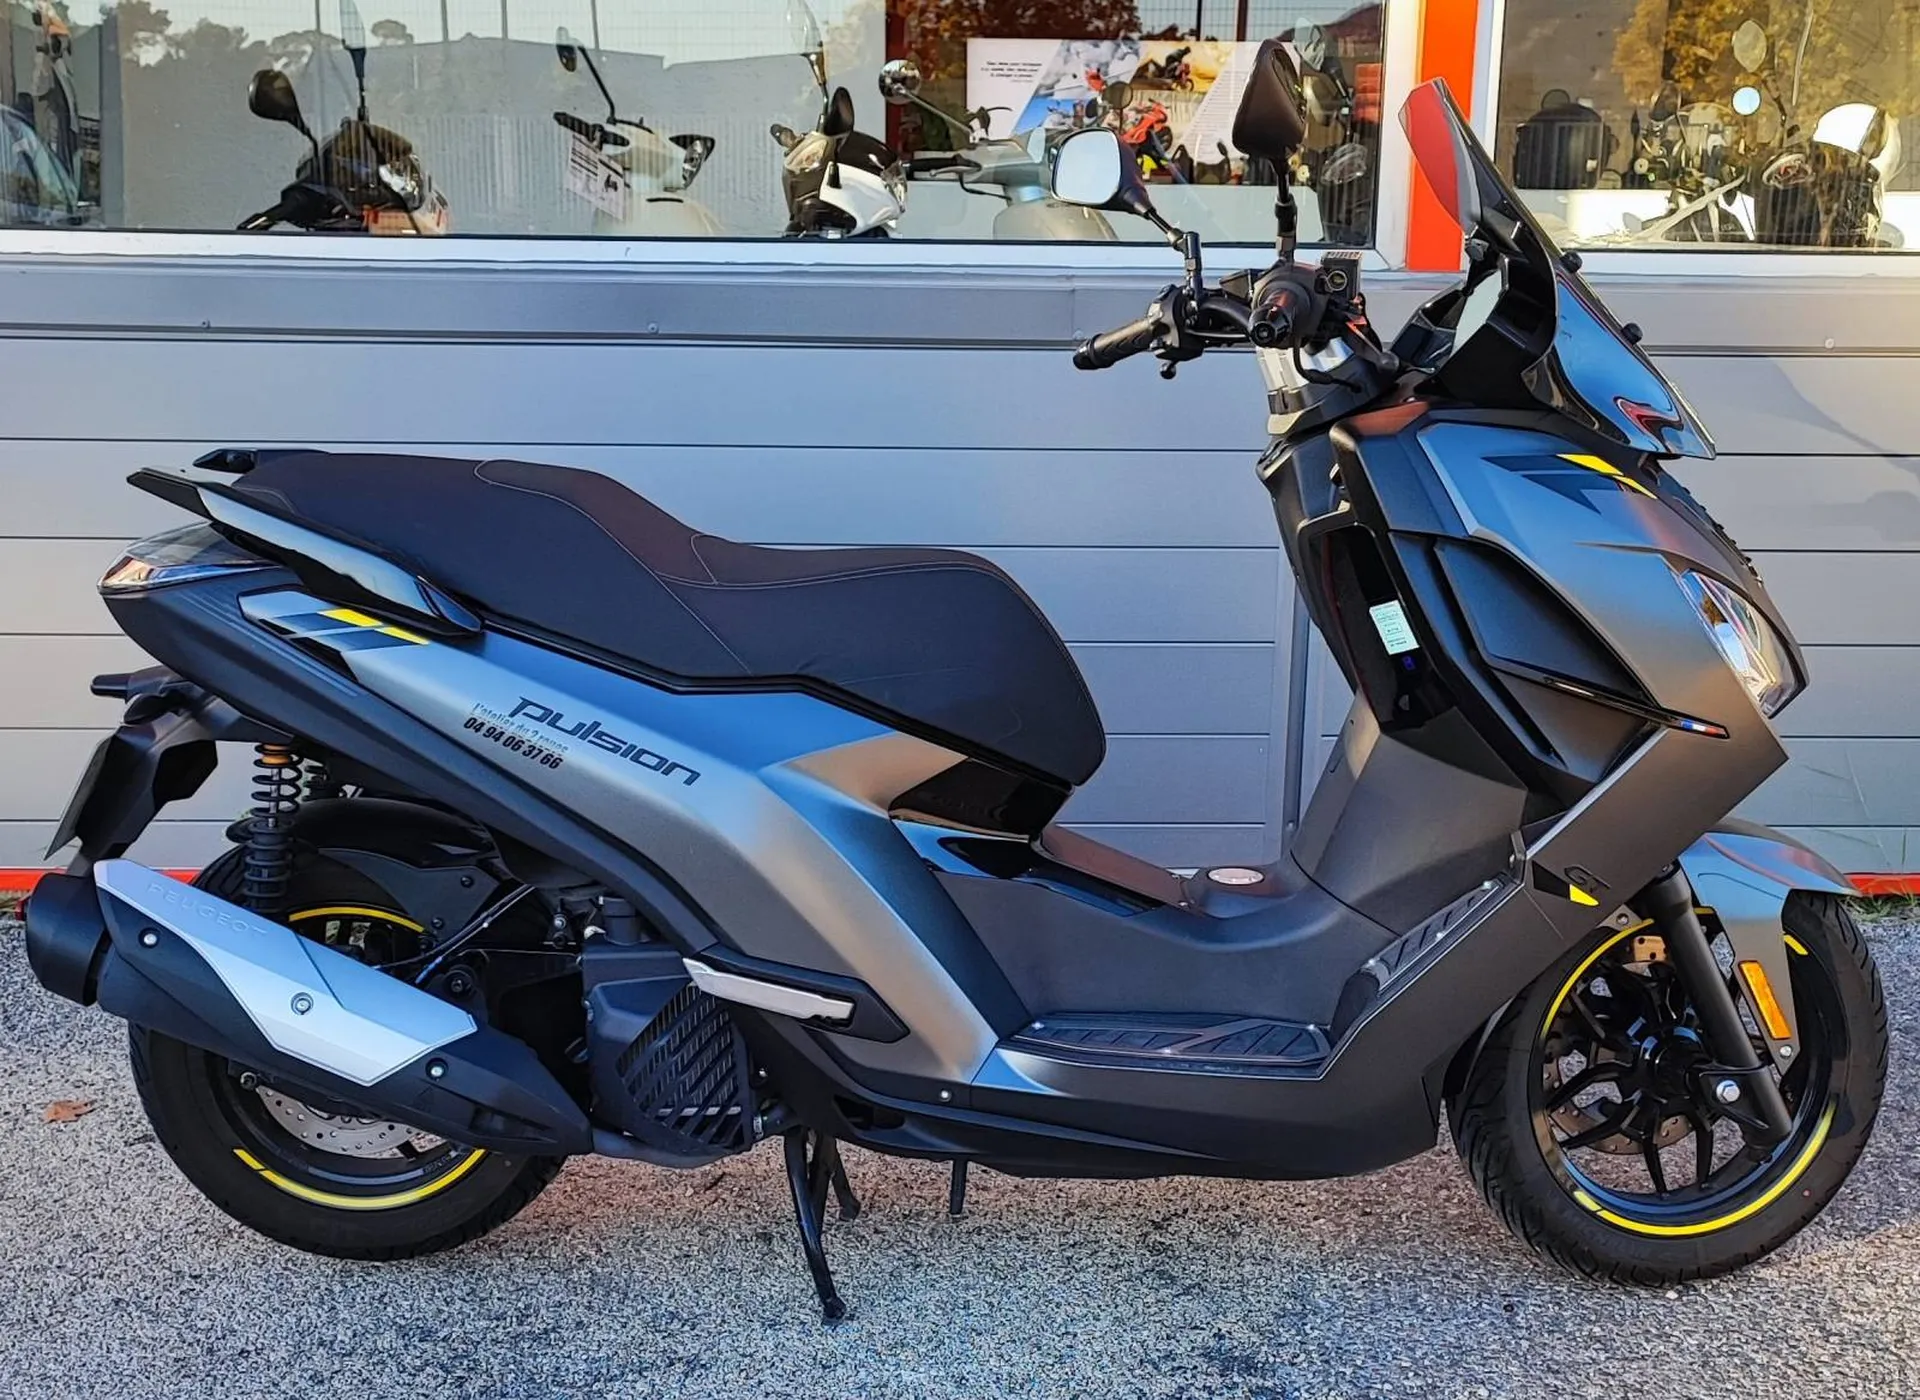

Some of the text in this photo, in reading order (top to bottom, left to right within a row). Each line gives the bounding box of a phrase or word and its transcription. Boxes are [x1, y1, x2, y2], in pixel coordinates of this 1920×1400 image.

[463, 717, 564, 769] 04 94 06 37 66
[1564, 865, 1611, 894] GT
[147, 882, 267, 934] PEUGEOT
